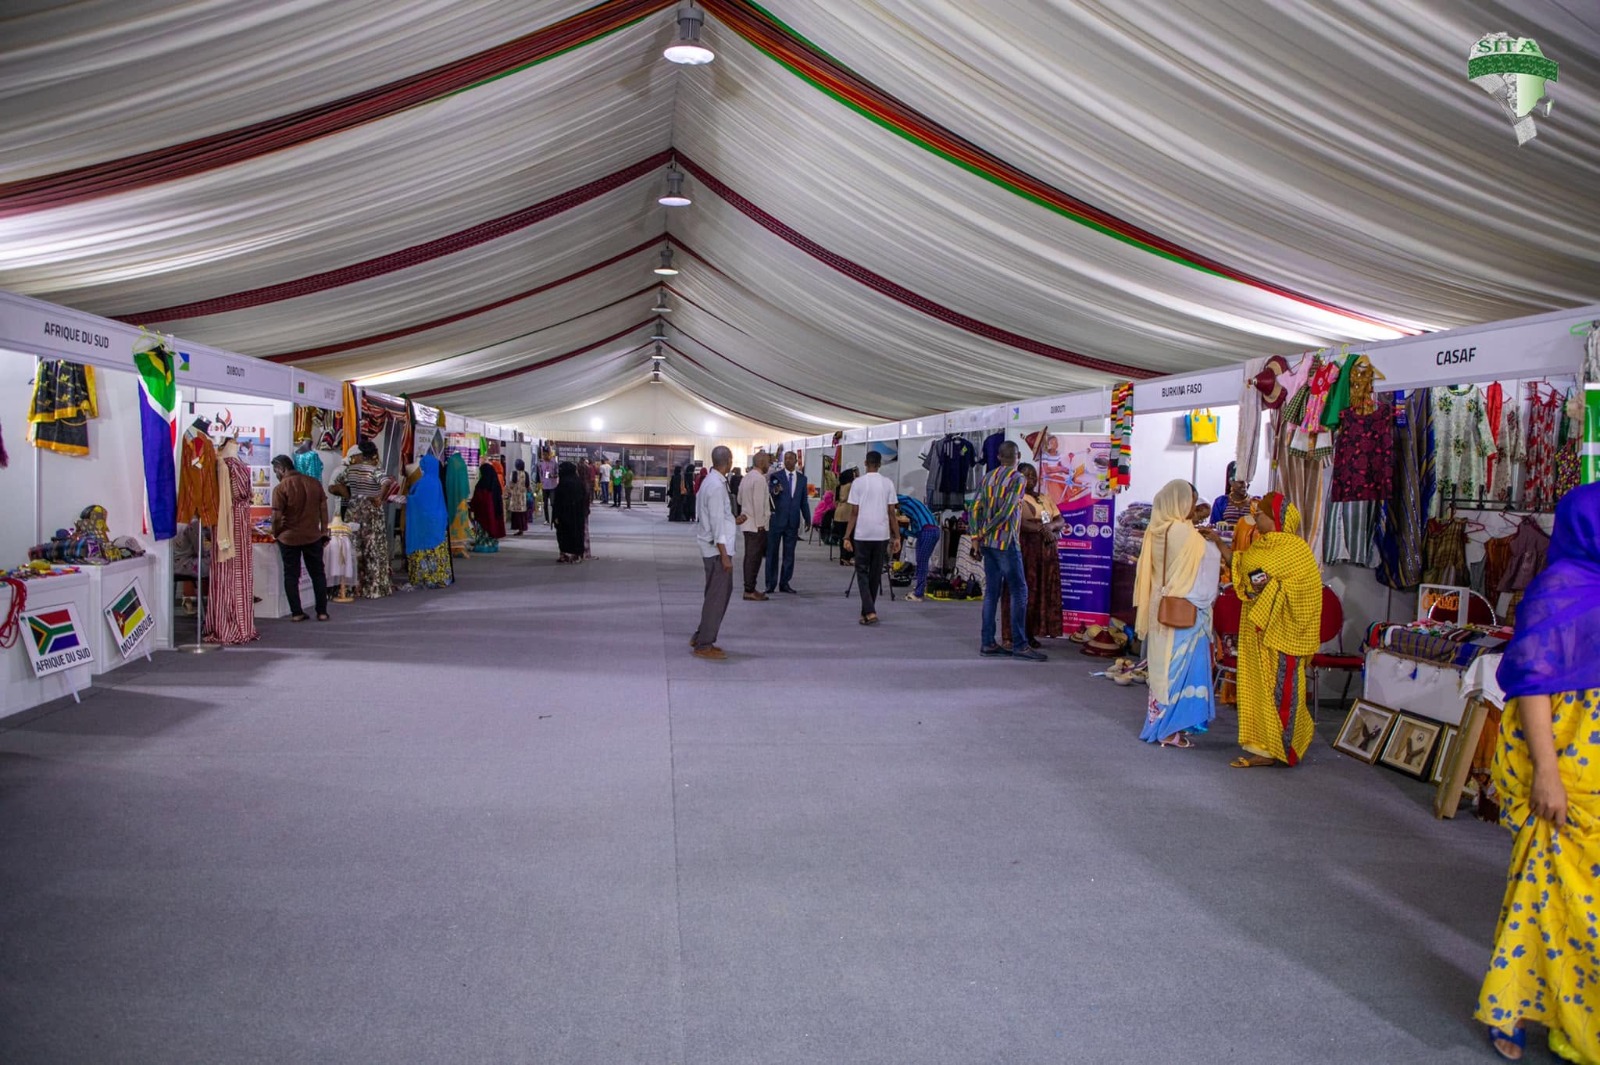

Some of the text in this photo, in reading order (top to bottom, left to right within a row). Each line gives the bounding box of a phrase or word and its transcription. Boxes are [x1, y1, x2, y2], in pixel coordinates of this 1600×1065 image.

[44, 321, 109, 349] AFRIQUE DU SUD
[1436, 347, 1476, 366] CASAF
[1161, 383, 1202, 397] BURKINA FASO
[121, 614, 154, 655] MOZAMBIQUE
[36, 647, 91, 673] AFRIQUE DU SUD
